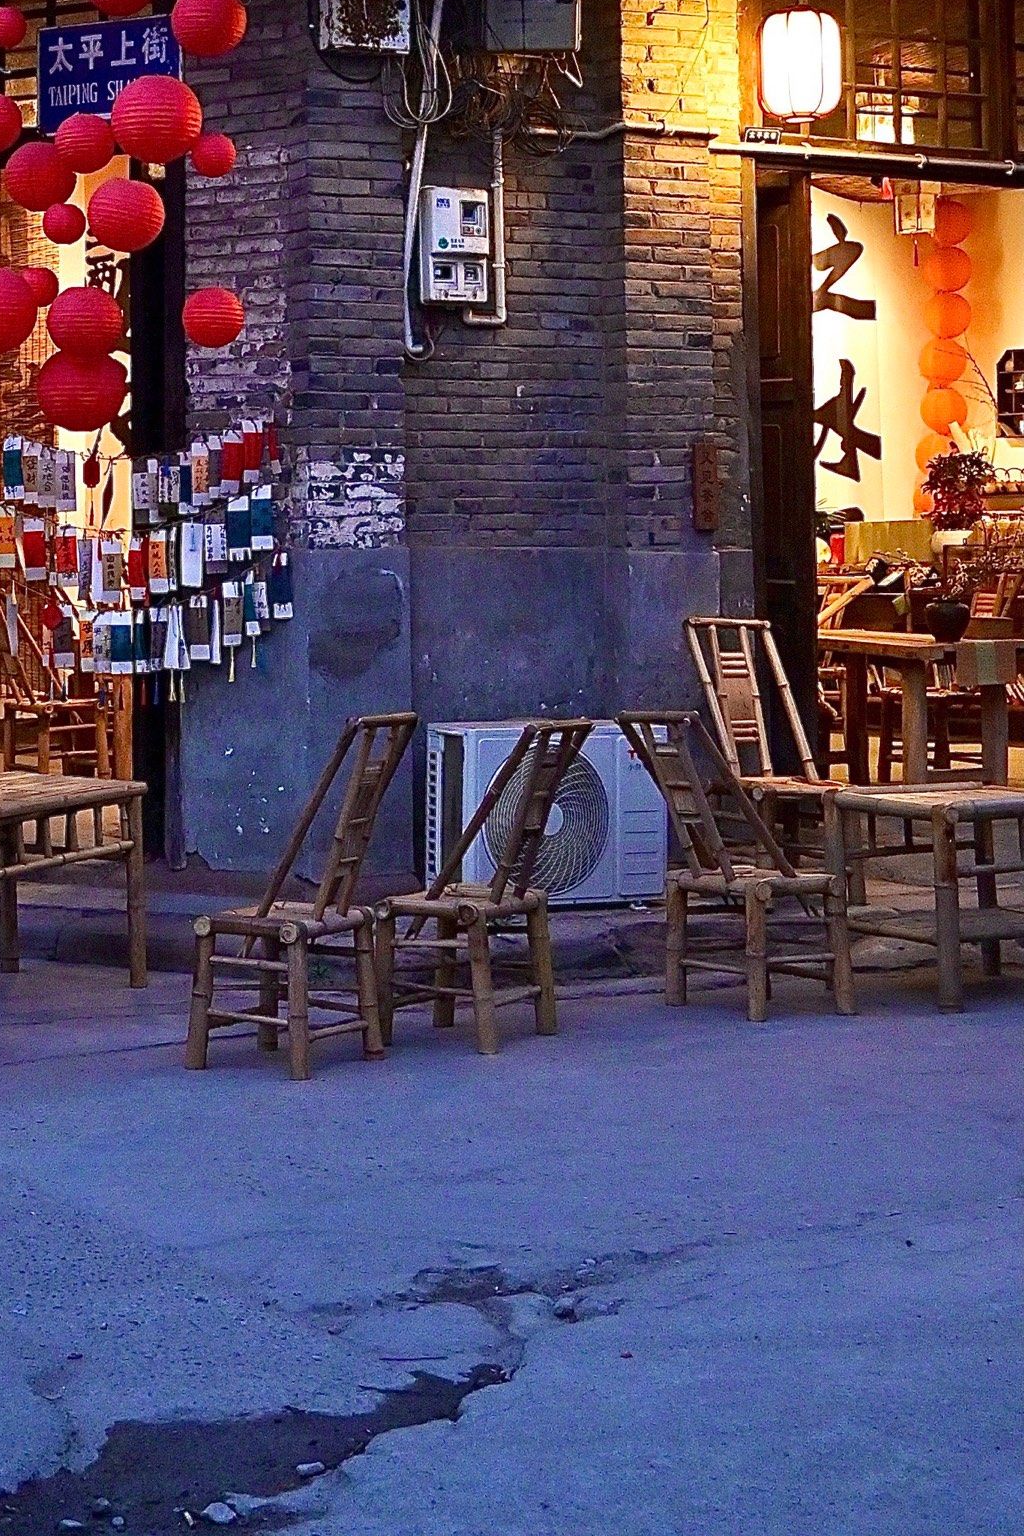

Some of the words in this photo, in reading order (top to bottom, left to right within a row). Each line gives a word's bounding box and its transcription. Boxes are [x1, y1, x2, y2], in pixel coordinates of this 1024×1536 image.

[48, 26, 169, 74] 太平上街
[48, 82, 98, 107] TAIPING
